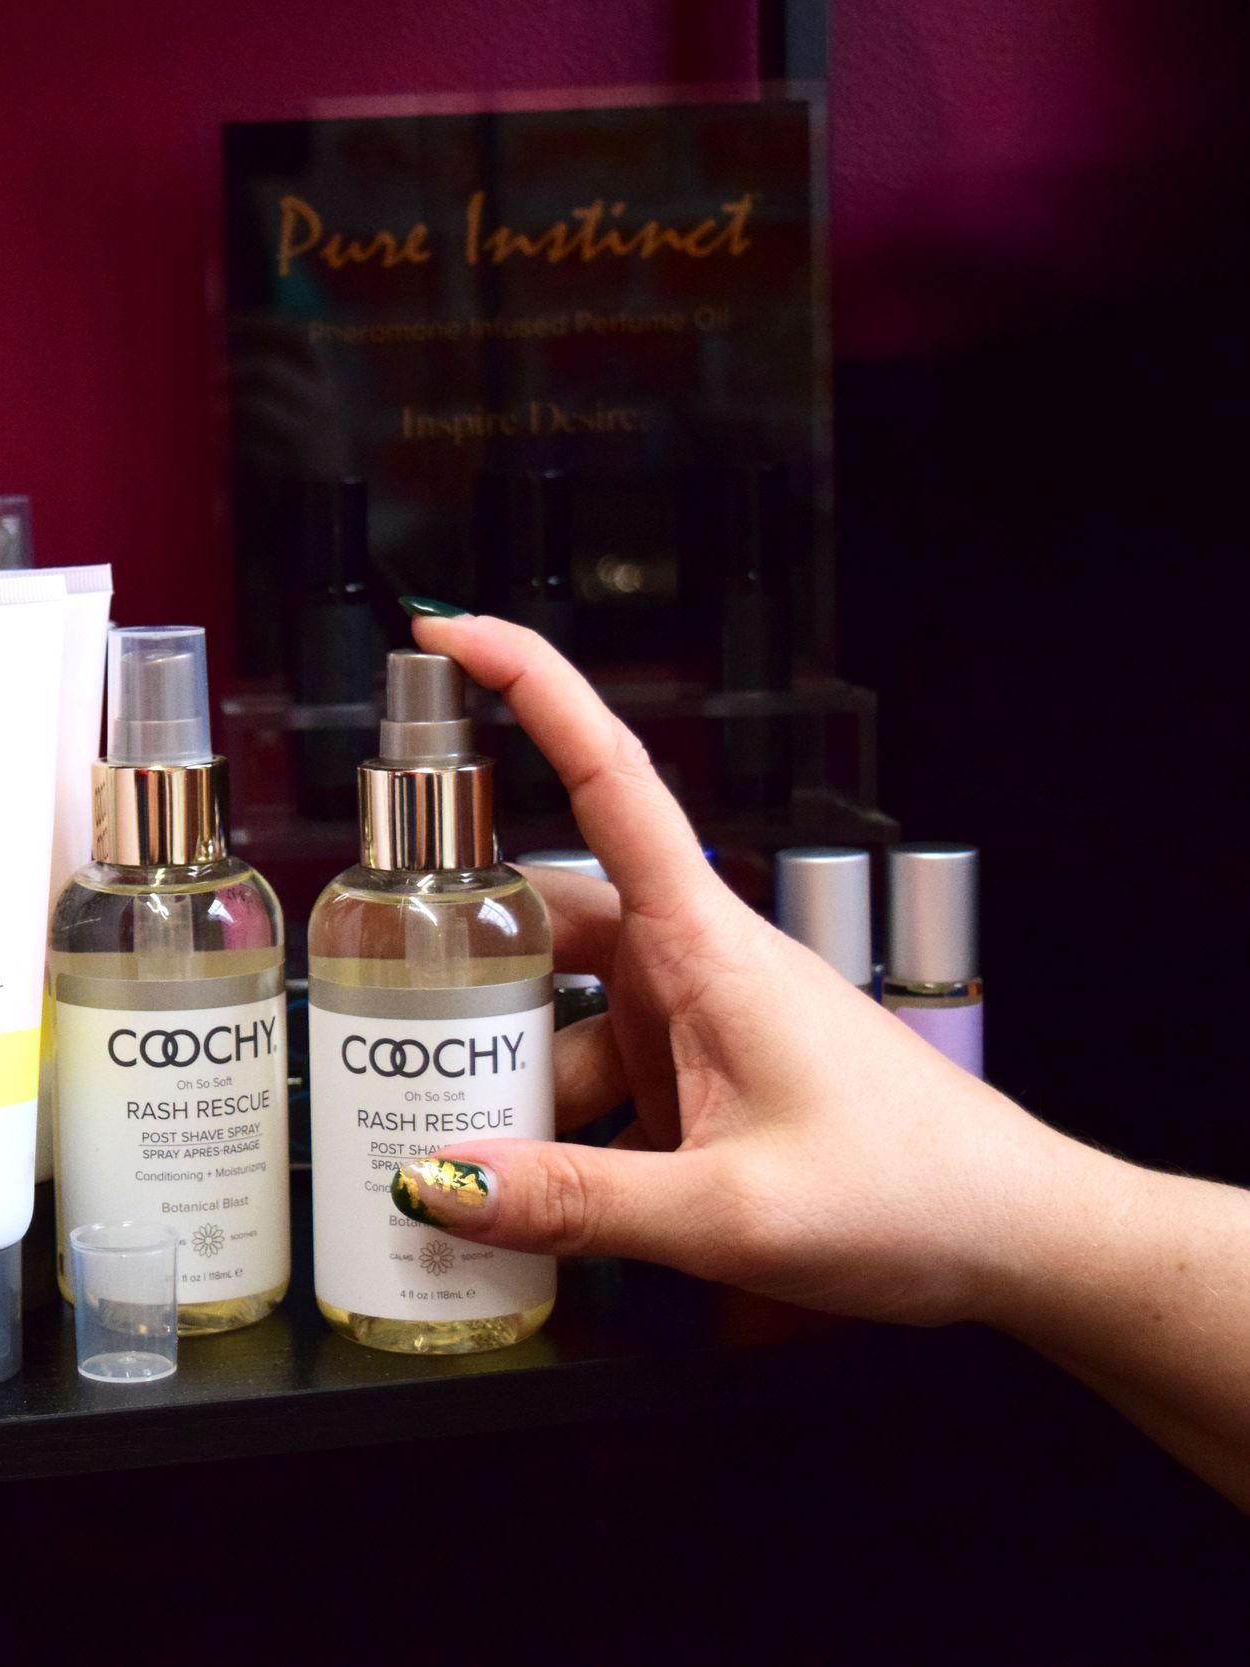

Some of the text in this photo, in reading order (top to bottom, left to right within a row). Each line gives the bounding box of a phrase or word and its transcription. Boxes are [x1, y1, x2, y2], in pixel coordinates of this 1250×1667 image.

[278, 191, 754, 277] Pure Instinct
[401, 404, 520, 445] Inspire
[176, 1075, 233, 1090] Oh So Soft
[126, 1089, 270, 1120] RASH RESCUE
[404, 1090, 465, 1102] Oh So Soft
[357, 1107, 513, 1132] RASH RESCUE
[141, 1122, 262, 1144] POST SHAVE SPRAY
[142, 1149, 181, 1160] SPRAY
[370, 1141, 452, 1156] POST SHA
[135, 1169, 204, 1183] Conditioning
[215, 1161, 267, 1179] Moisturizing
[161, 1195, 250, 1214] Botanical Blast
[190, 1273, 201, 1283] oz
[400, 1290, 406, 1299] 4
[416, 1291, 429, 1300] oz
